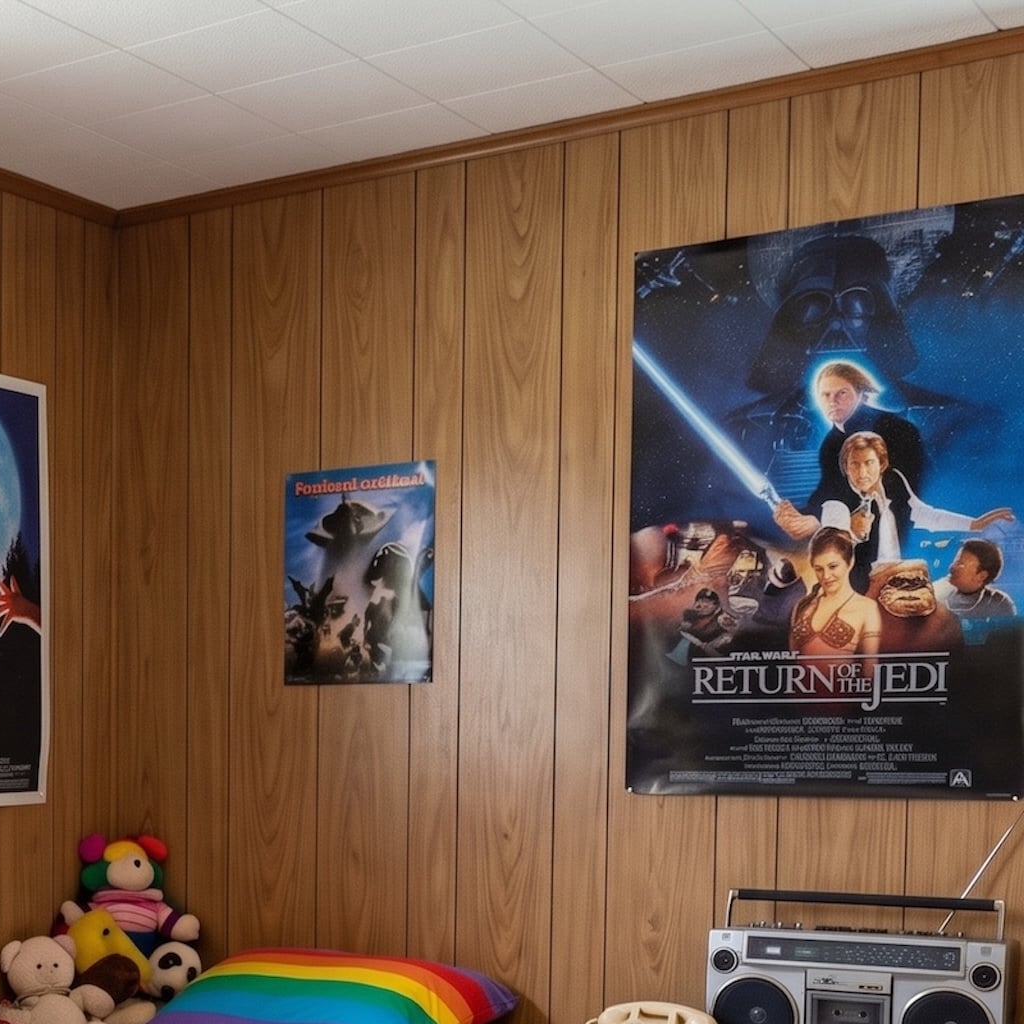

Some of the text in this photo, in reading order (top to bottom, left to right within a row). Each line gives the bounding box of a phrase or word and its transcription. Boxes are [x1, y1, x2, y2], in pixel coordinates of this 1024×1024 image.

[729, 651, 762, 661] STAR
[693, 661, 949, 712] RETURN OF THE JEDI
